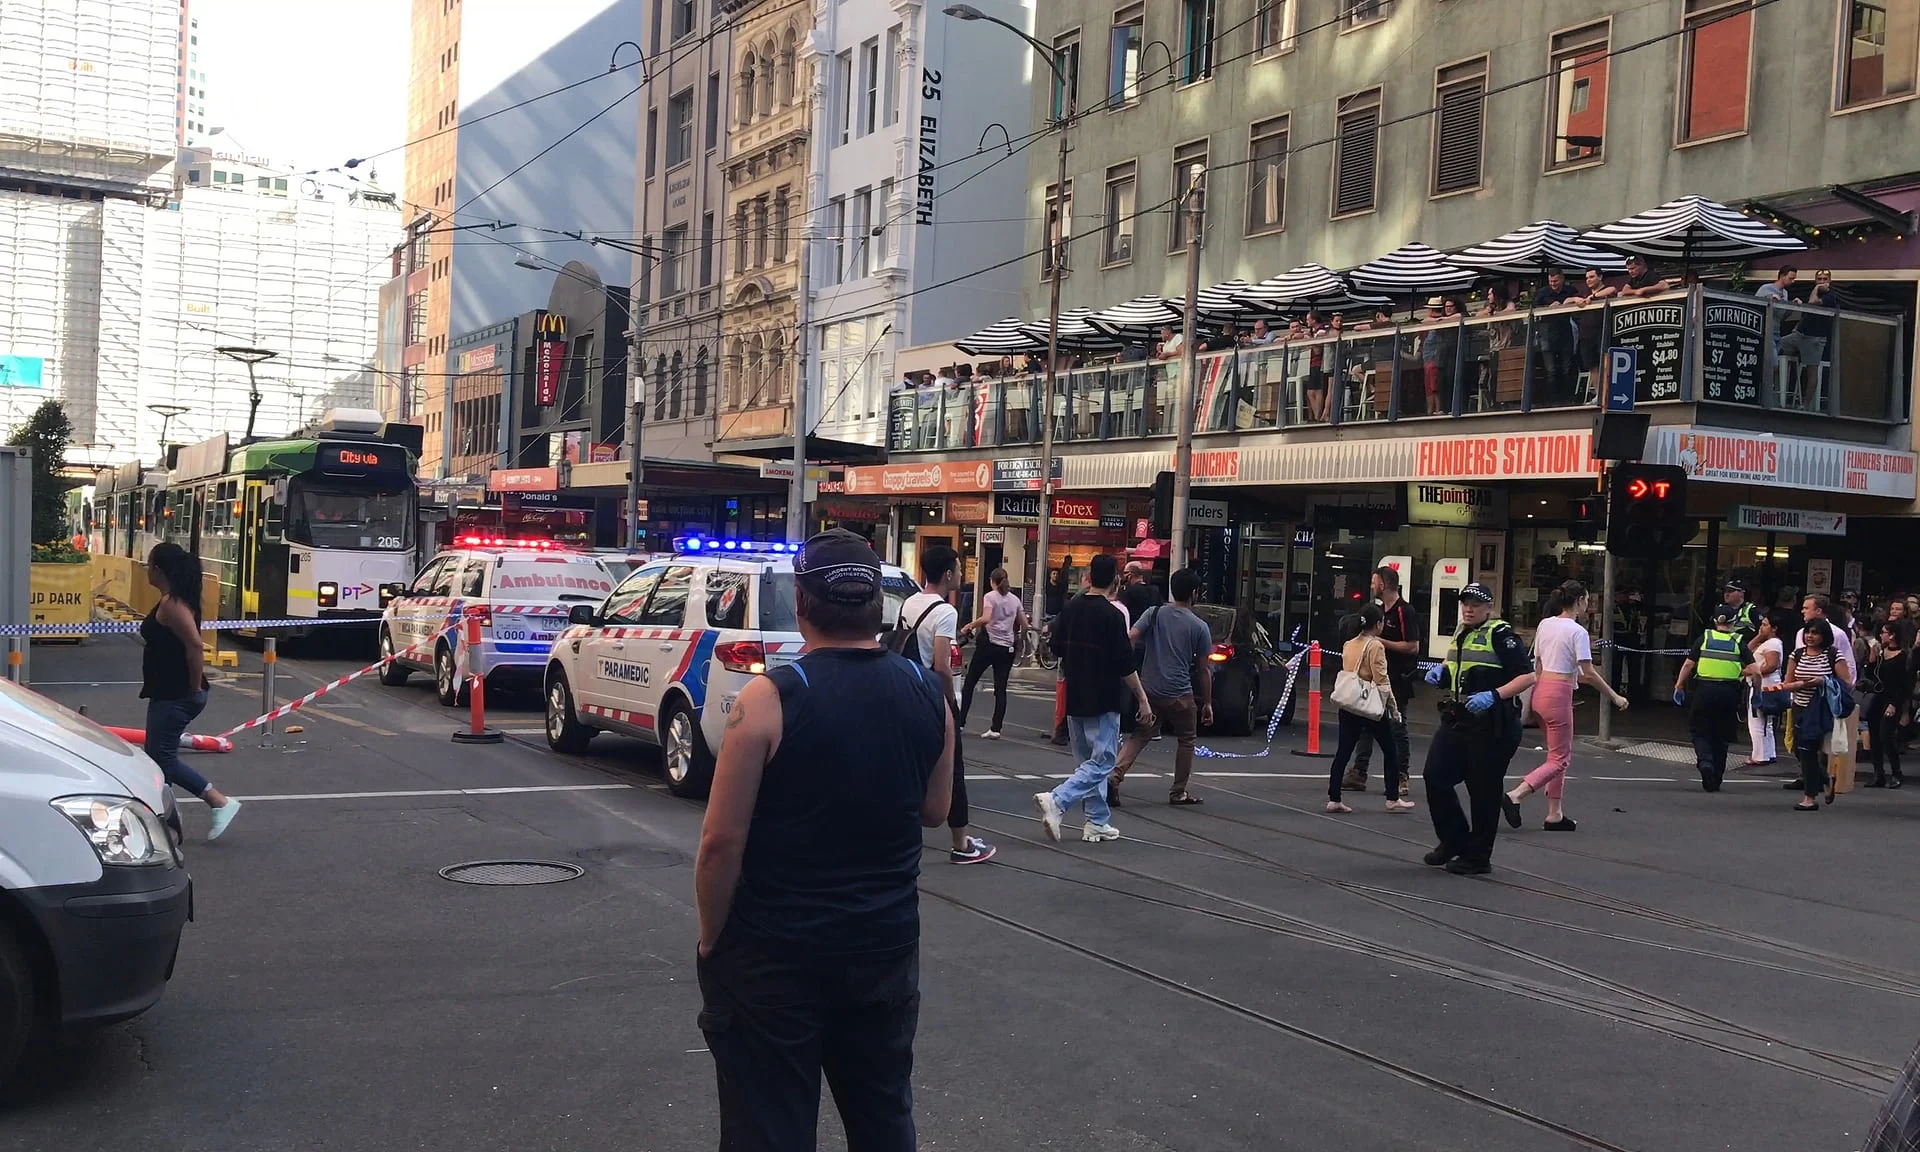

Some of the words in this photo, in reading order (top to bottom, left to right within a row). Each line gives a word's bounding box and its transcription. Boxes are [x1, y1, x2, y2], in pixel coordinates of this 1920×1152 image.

[922, 66, 942, 101] 25
[916, 115, 937, 226] ELIZABETH
[1617, 308, 1679, 331] SMIRNOFF
[1708, 308, 1759, 329] SMIRNOFF
[1652, 349, 1679, 367] $4.80
[1711, 348, 1724, 364] $7
[1736, 352, 1758, 368] $4.80
[1611, 351, 1632, 384] P
[1651, 382, 1678, 398] $5.50
[1709, 381, 1721, 398] $5
[1734, 384, 1756, 400] $5.50
[339, 450, 361, 464] City
[362, 452, 378, 465] via
[1024, 459, 1058, 469] EXCHGE
[1419, 438, 1498, 476] FLINDERS
[1502, 434, 1581, 474] STATION
[1705, 435, 1777, 474] DUNCAN'S
[1847, 450, 1882, 471] FLINDERS
[1883, 454, 1914, 474] STATION
[1846, 470, 1868, 490] HOTEL
[1001, 496, 1041, 513] Raffle
[1055, 499, 1094, 516] Forex
[377, 536, 401, 548] 205
[300, 552, 311, 562] 205
[500, 573, 611, 593] Ambulance
[49, 592, 82, 605] PARK
[504, 630, 526, 641] 000
[604, 660, 649, 685] PARAMEDIC
